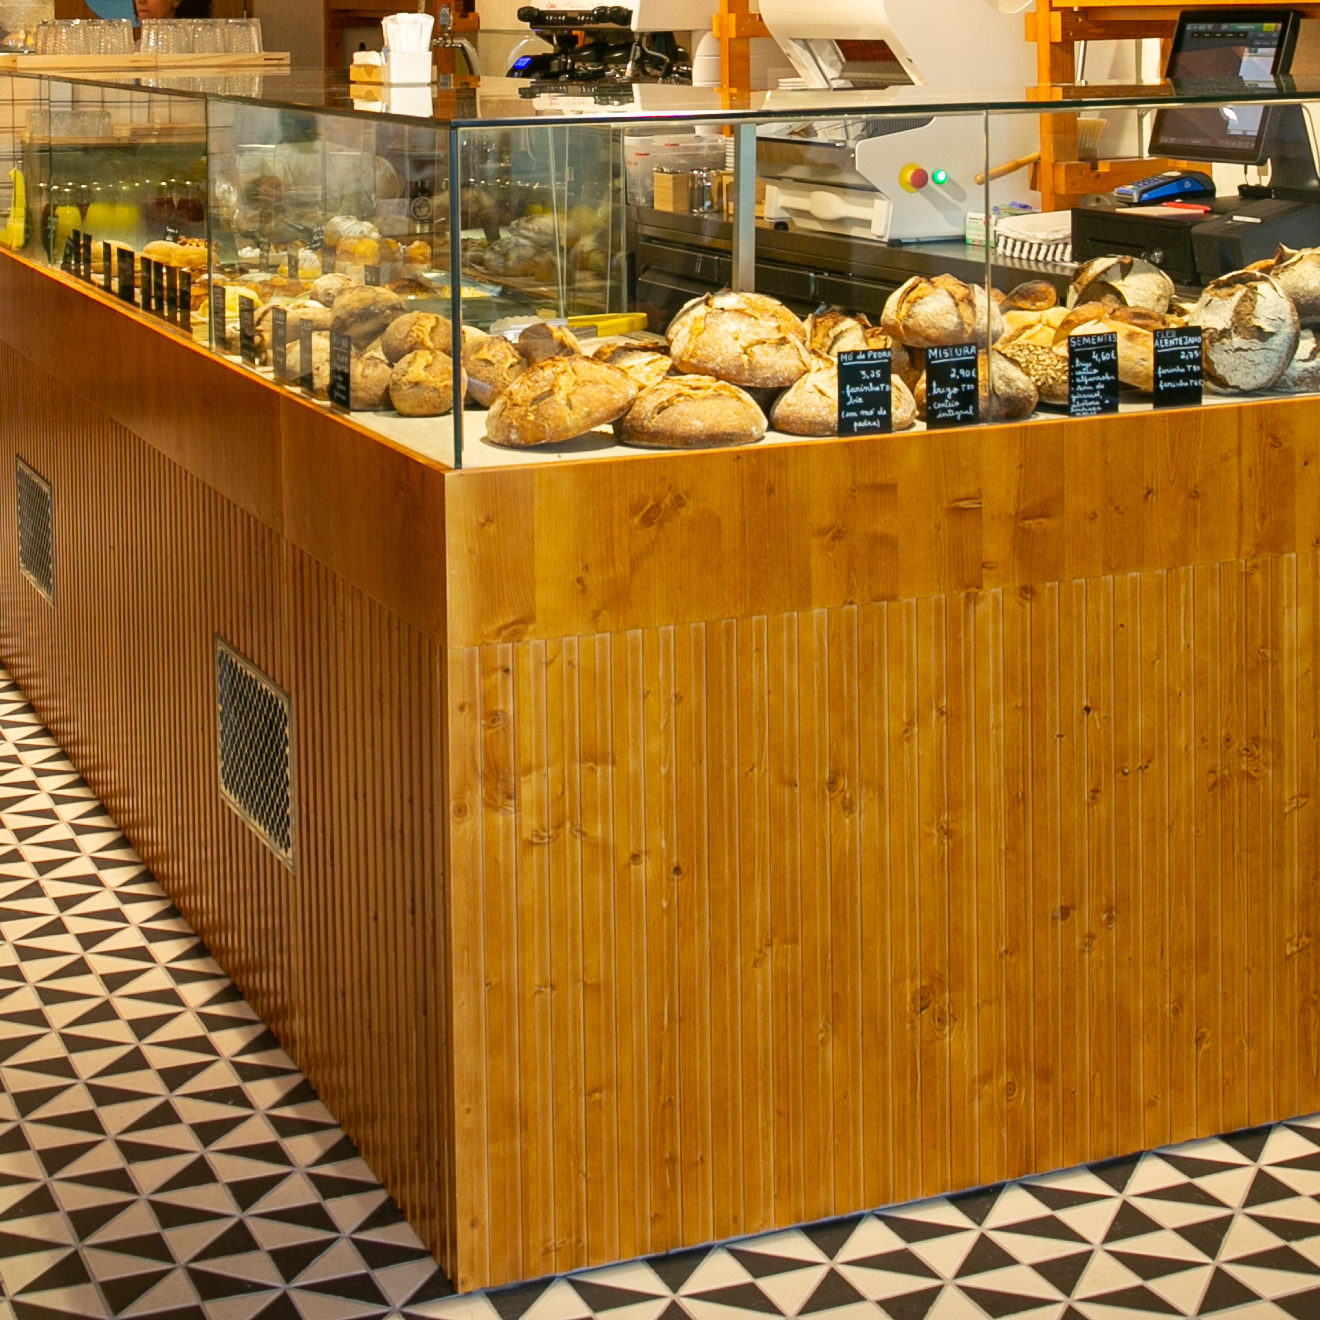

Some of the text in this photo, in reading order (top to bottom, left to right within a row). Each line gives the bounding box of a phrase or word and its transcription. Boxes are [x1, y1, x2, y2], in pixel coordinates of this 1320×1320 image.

[1070, 333, 1117, 347] SEMENTES
[1154, 336, 1202, 347] ALENTEJANO
[867, 350, 891, 359] PEDRA
[928, 345, 976, 359] MISTURA
